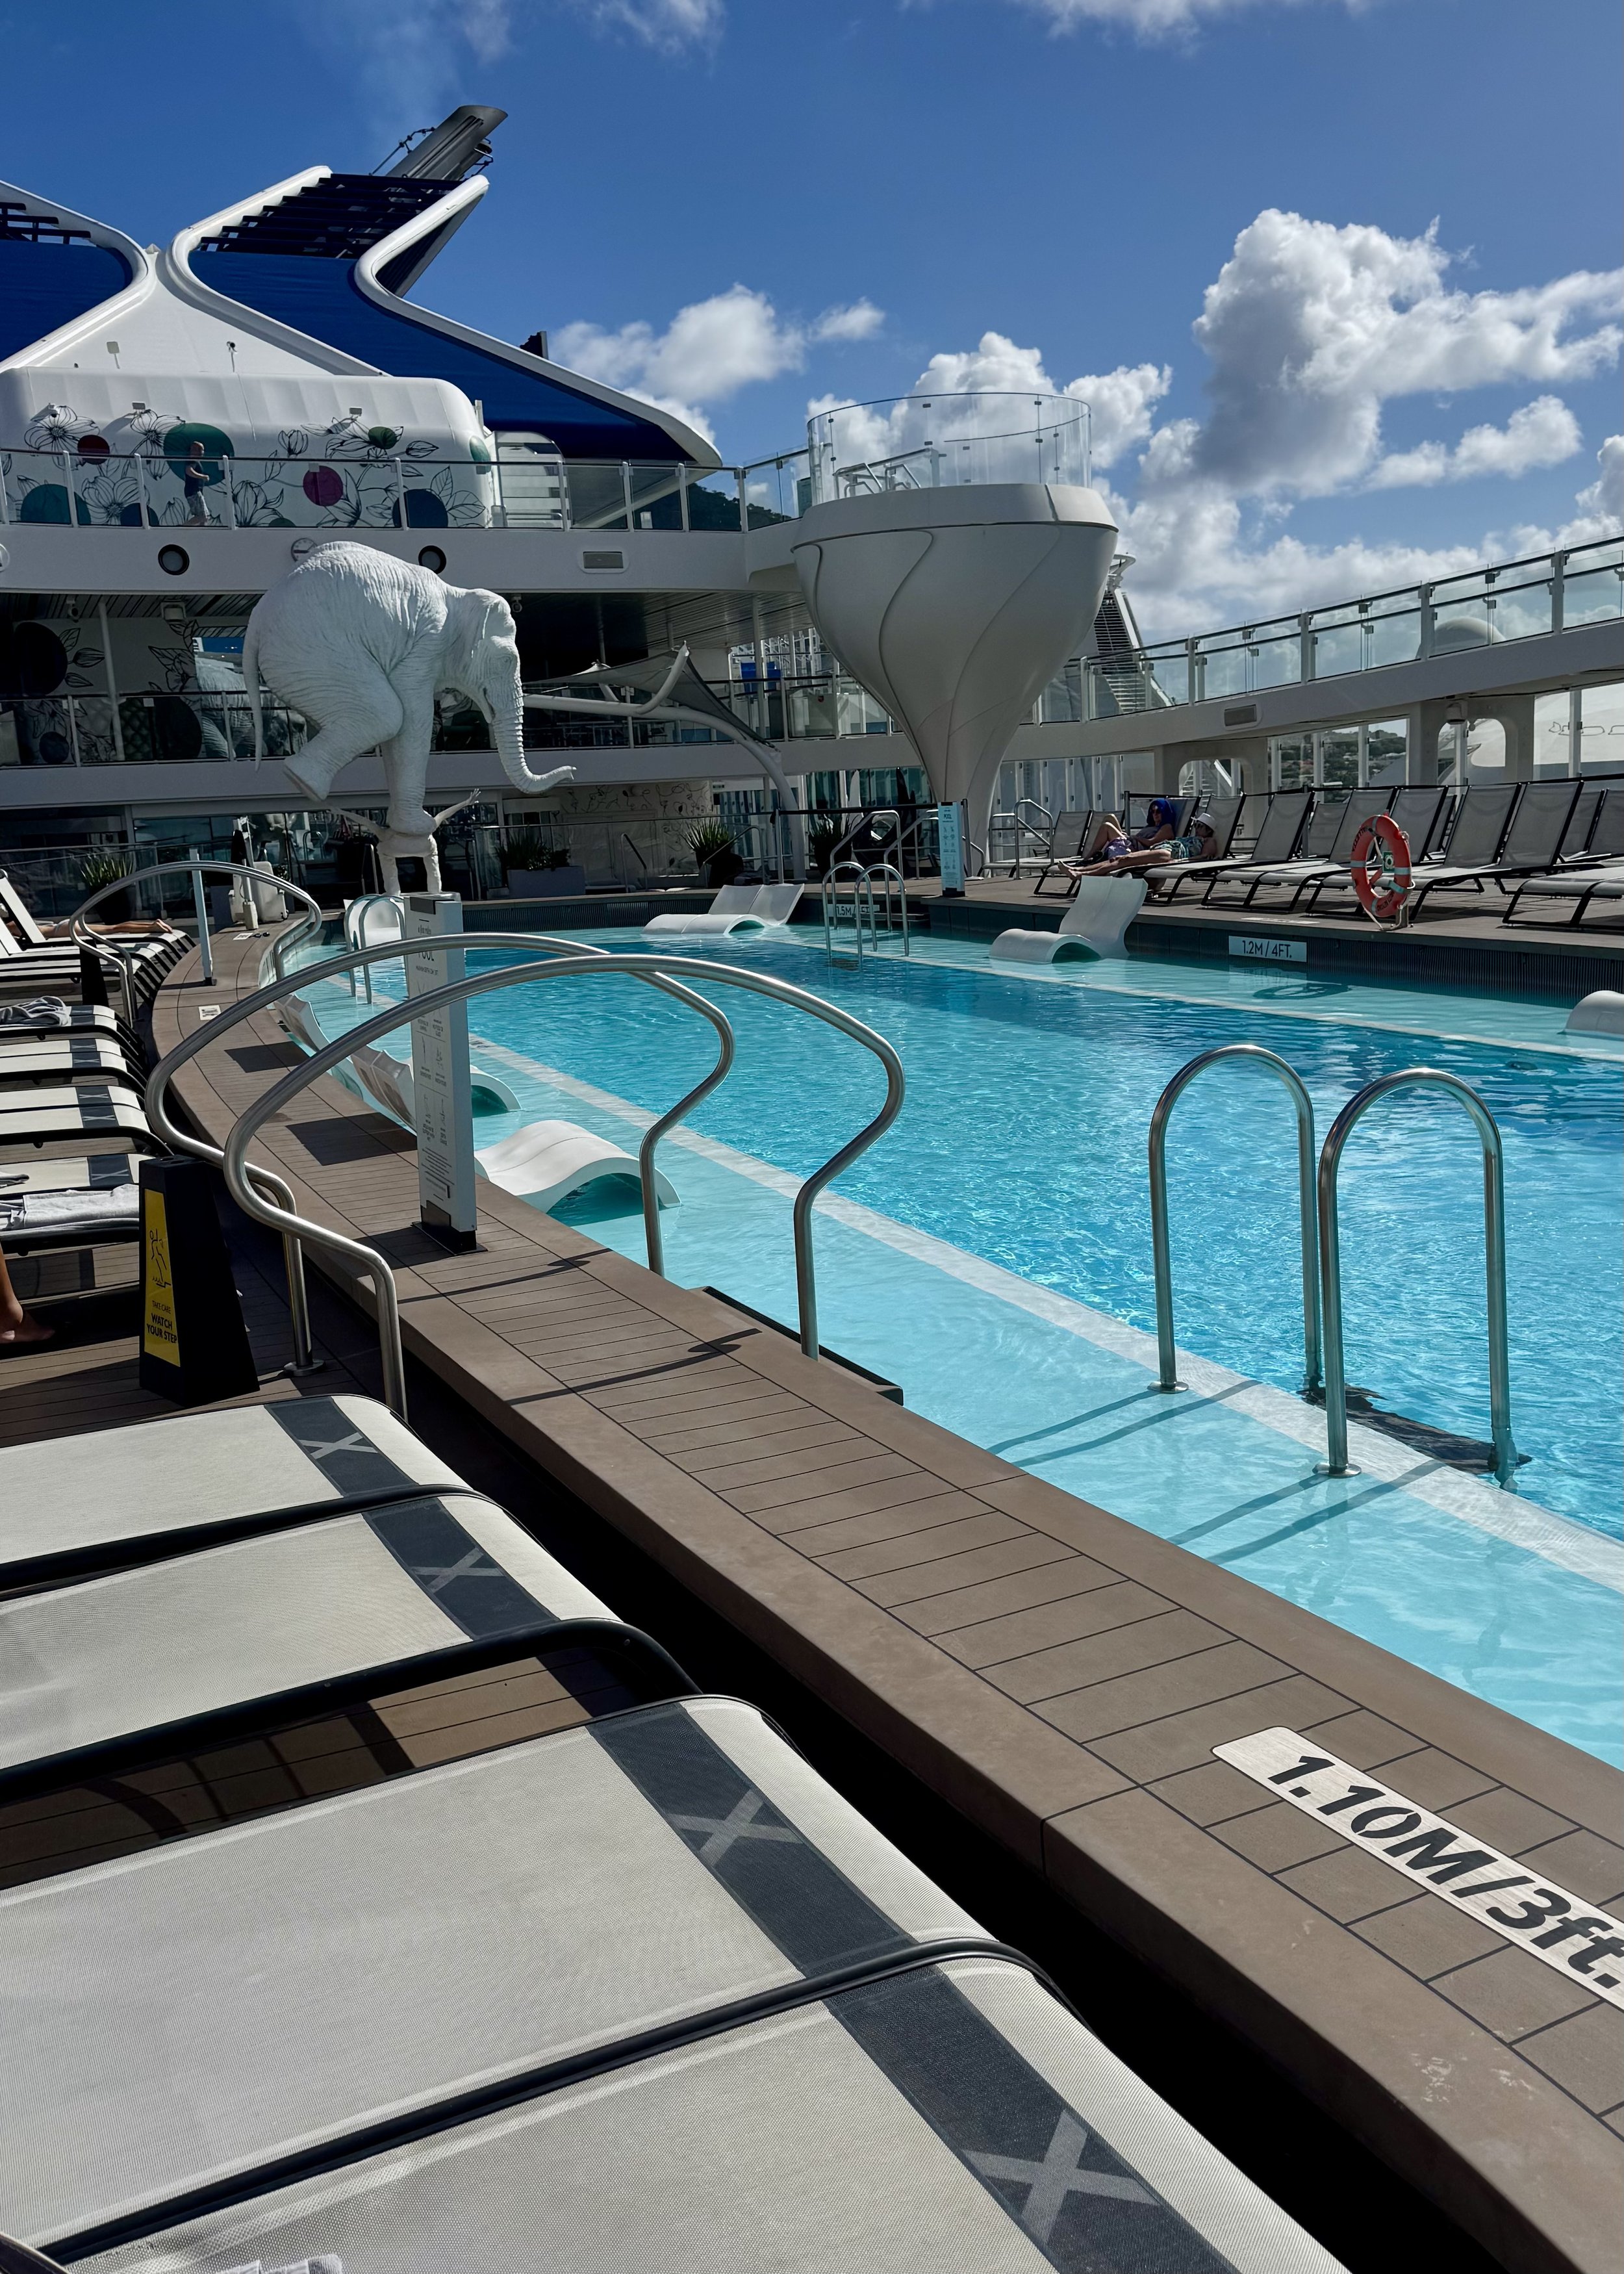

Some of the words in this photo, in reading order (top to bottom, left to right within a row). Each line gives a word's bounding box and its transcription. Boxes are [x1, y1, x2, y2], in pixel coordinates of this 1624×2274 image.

[1242, 940, 1263, 955] 1.2M
[1265, 941, 1269, 957] /
[1271, 943, 1292, 958] 4FT.
[151, 1313, 172, 1331] WATCH
[147, 1323, 163, 1338] YOUR
[164, 1331, 177, 1344] STEP
